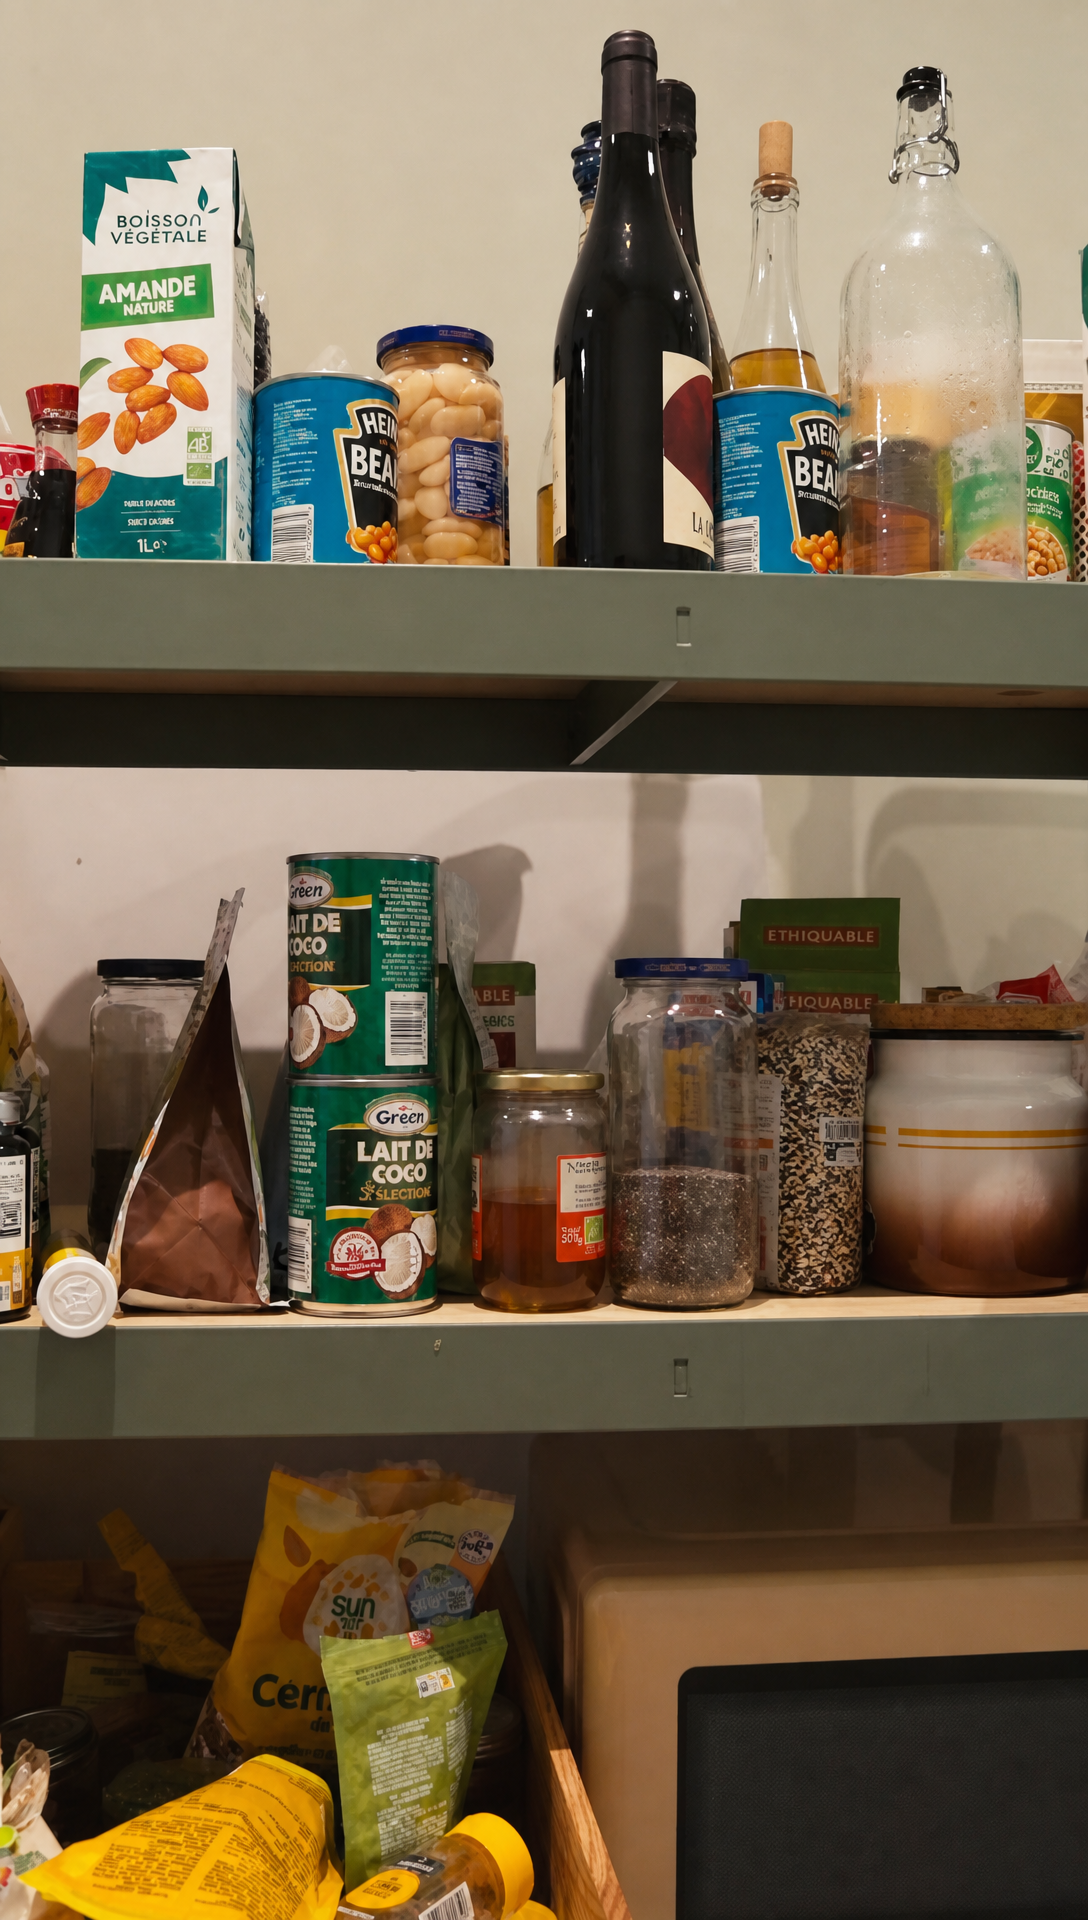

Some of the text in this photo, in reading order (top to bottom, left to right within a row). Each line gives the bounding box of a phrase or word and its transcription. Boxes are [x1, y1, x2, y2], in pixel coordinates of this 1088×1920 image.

[110, 228, 207, 245] VÉGÉTALE
[98, 275, 197, 305] AMANDE
[123, 299, 175, 316] NATURE
[312, 912, 342, 933] DE
[768, 929, 875, 943] ETHIQUABLE
[376, 1110, 424, 1125] Green
[357, 1139, 433, 1162] LAIT DE
[372, 1162, 427, 1184] COCO
[331, 1594, 376, 1619] sun
